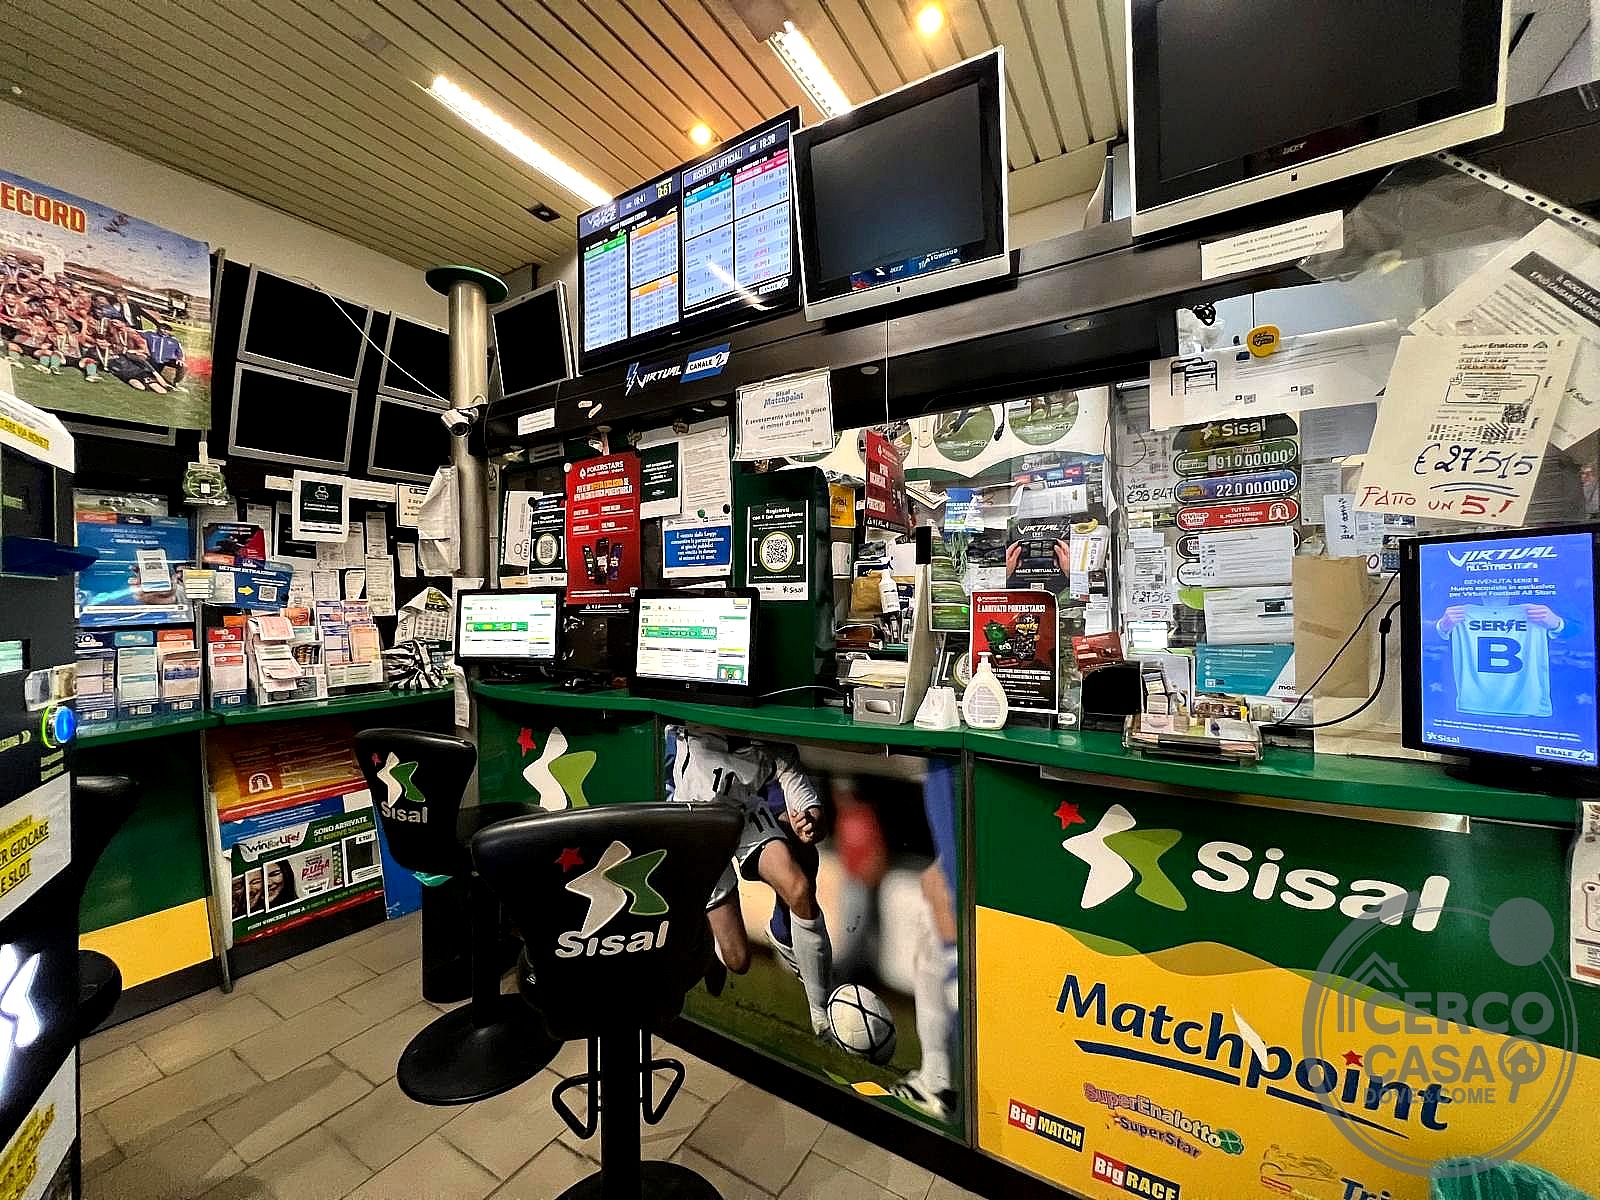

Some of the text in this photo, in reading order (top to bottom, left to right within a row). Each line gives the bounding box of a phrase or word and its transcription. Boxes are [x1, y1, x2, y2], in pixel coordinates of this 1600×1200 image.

[718, 148, 743, 168] UFFICIALI
[0, 182, 86, 233] ECORD
[636, 353, 725, 389] VIRTUAL CANALE 2
[763, 391, 804, 409] Matchpoint
[750, 414, 784, 425] severamente
[785, 409, 805, 419] vietato
[810, 406, 826, 415] gioco
[766, 421, 784, 429] minori
[791, 418, 804, 426] anni
[1221, 418, 1266, 437] Sisal
[586, 460, 624, 473] POKERSTARS
[1359, 486, 1417, 508] FATTO
[1428, 500, 1455, 511] UN
[765, 506, 790, 515] Registrati
[1017, 523, 1060, 535] VIRTUAL
[1447, 545, 1559, 568] VIRTUAL
[789, 586, 804, 594] Sisal
[1448, 591, 1462, 599] per
[981, 604, 1008, 613] ARRIVATO
[1007, 604, 1046, 613] POKERSTARS!
[1477, 636, 1524, 675] B
[1437, 733, 1460, 744] Sisal
[1539, 747, 1573, 757] CANALE
[711, 767, 736, 797] 11
[380, 800, 428, 824] Sisal
[10, 820, 50, 858] GIOCARE
[8, 858, 32, 887] SLOT
[1191, 840, 1451, 933] Sisal
[554, 919, 670, 959] Sisal
[1055, 973, 1453, 1131] Matchpoint
[1083, 1082, 1222, 1148] SuperEnalotto
[1117, 1116, 1202, 1159] SuperStar
